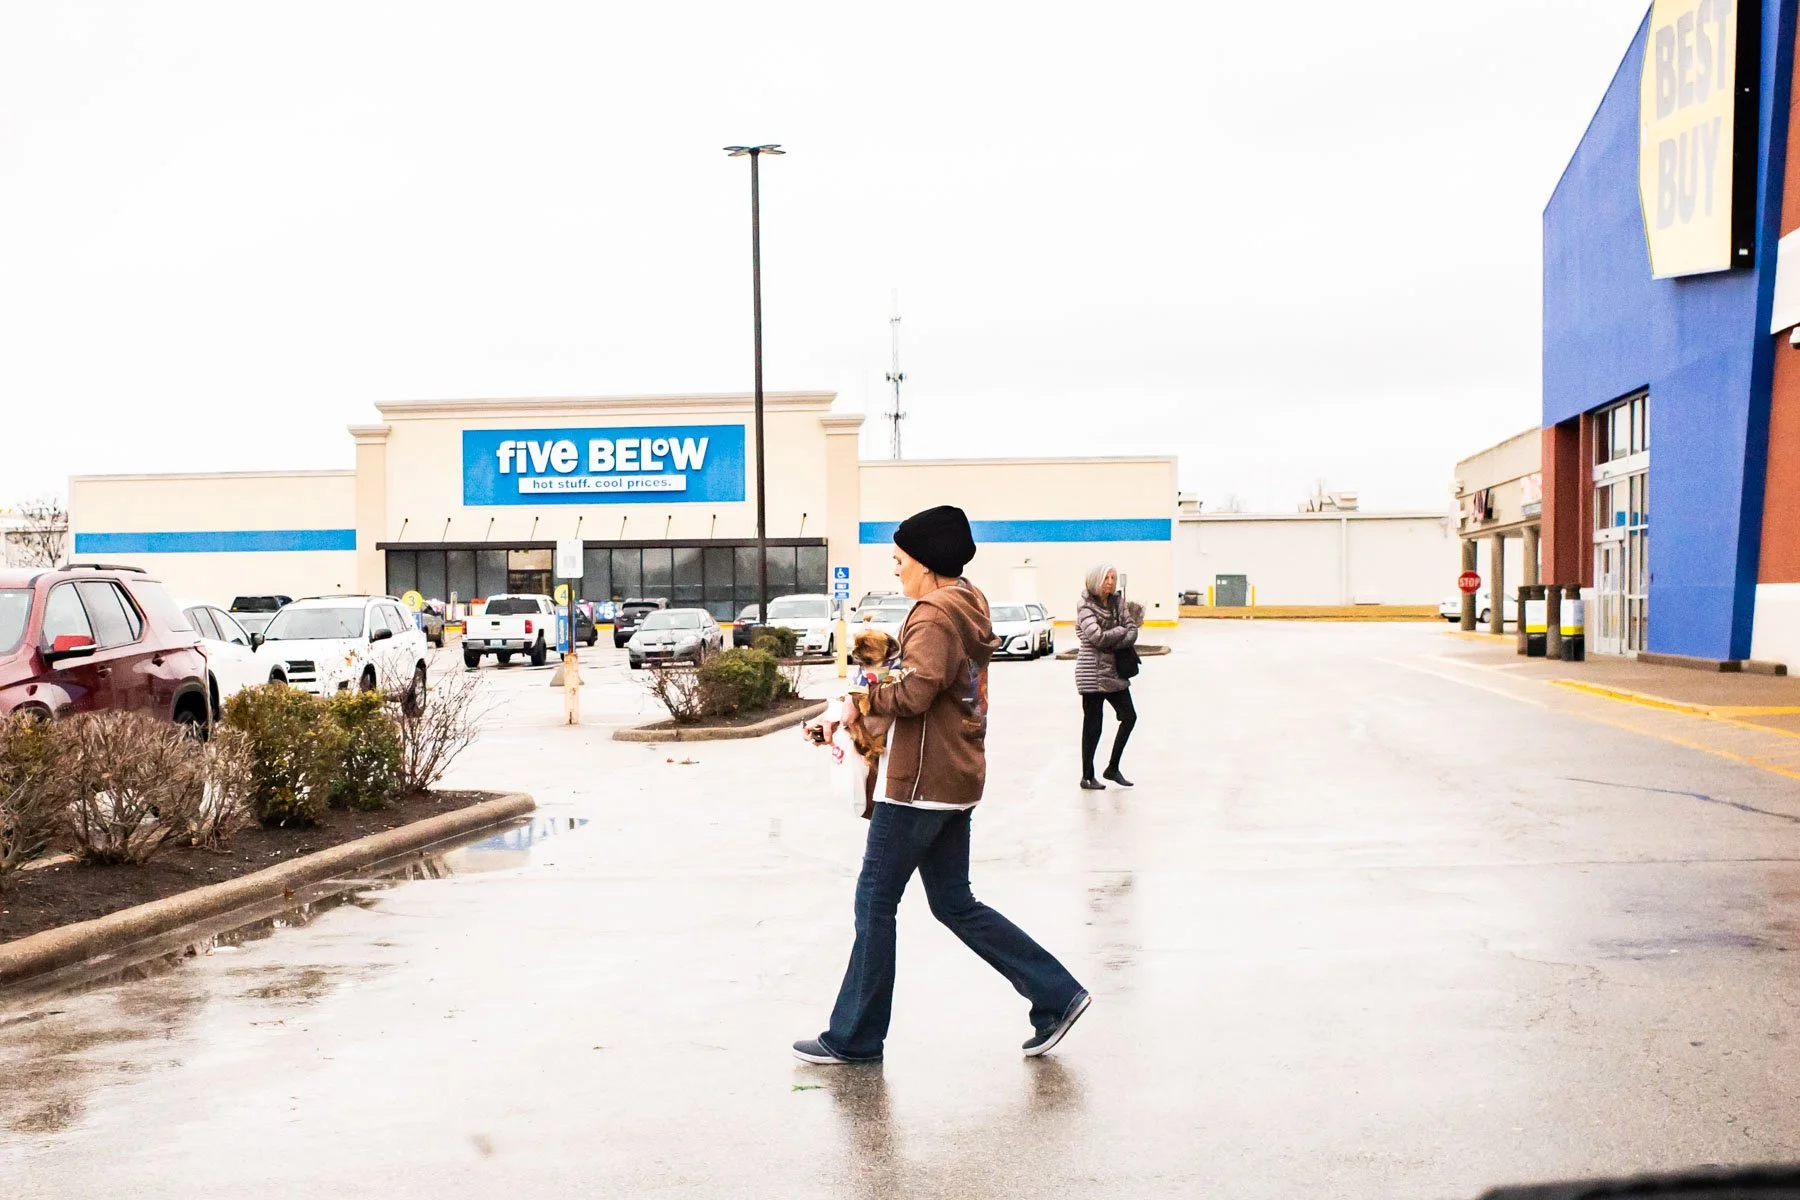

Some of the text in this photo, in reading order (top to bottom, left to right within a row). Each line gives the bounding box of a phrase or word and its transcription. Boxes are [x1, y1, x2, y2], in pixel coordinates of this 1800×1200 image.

[1656, 0, 1731, 120] BEST
[1656, 116, 1721, 230] BUY
[496, 440, 578, 473] five
[533, 475, 672, 491] hot stuff. cool prices.
[1459, 577, 1480, 588] STOP
[408, 595, 416, 607] 3
